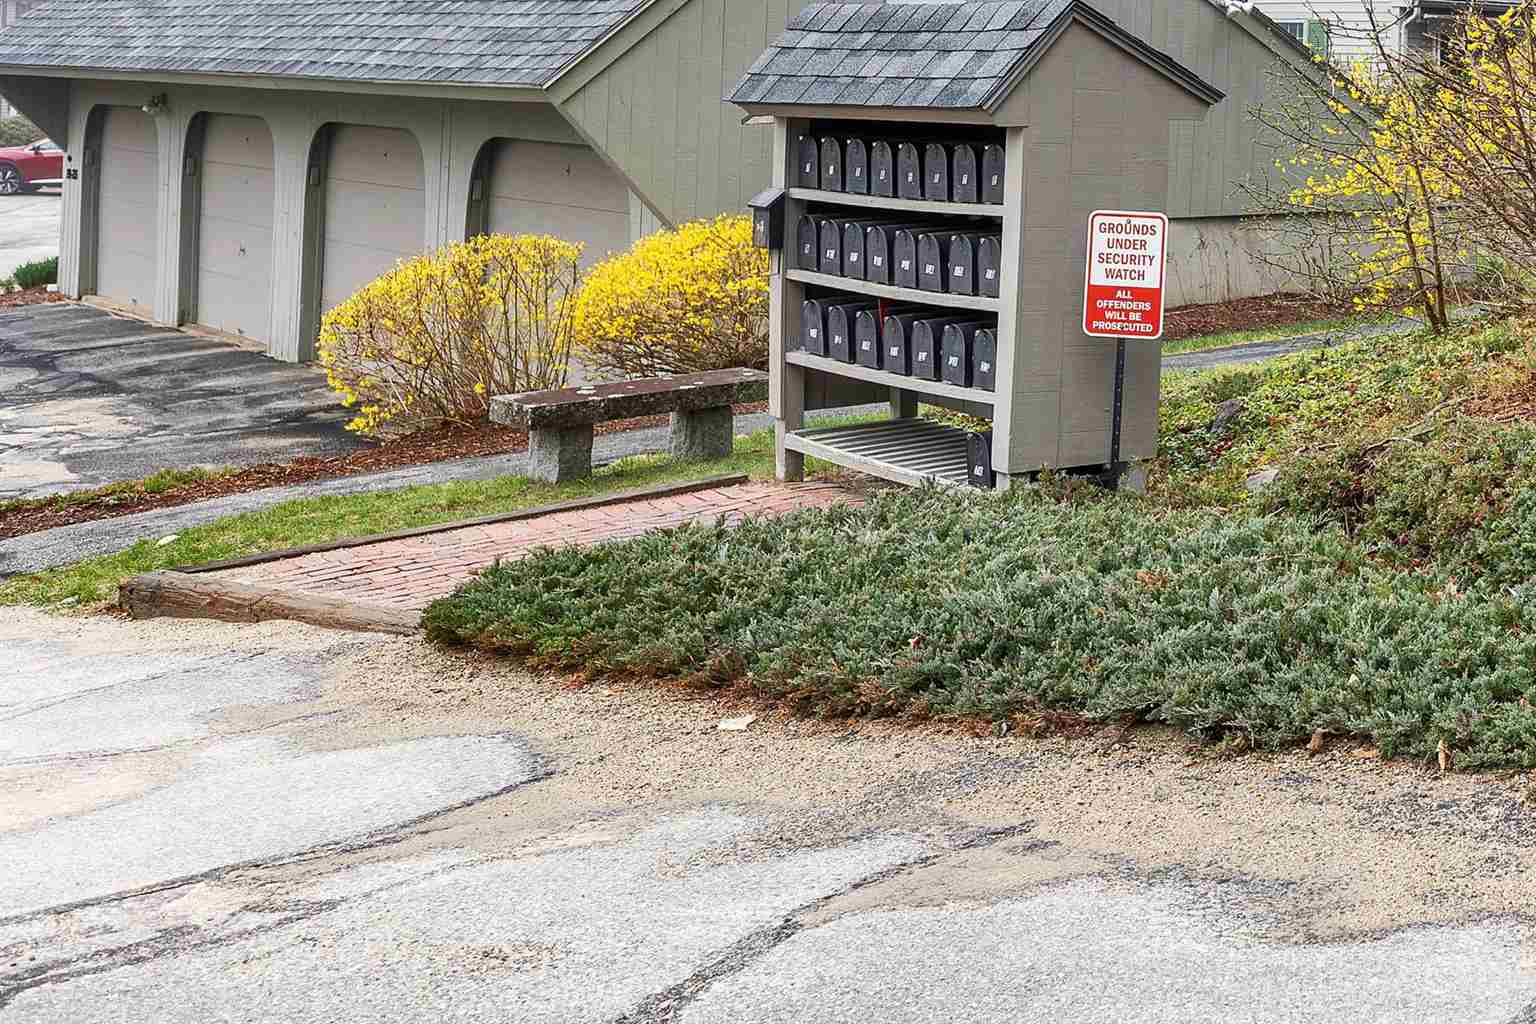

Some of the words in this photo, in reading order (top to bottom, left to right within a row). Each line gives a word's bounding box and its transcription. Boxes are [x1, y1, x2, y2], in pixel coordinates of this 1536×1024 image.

[1098, 222, 1157, 236] GROUNDS
[1107, 238, 1147, 250] UNDER
[1097, 252, 1155, 266] SECURITY
[1104, 268, 1145, 281] WATCH
[1115, 289, 1133, 299] ALL
[1096, 299, 1152, 311] OFFENDERS
[1104, 310, 1127, 320] WILL
[1128, 312, 1143, 321] BE
[1092, 321, 1153, 332] PROSECUTED
